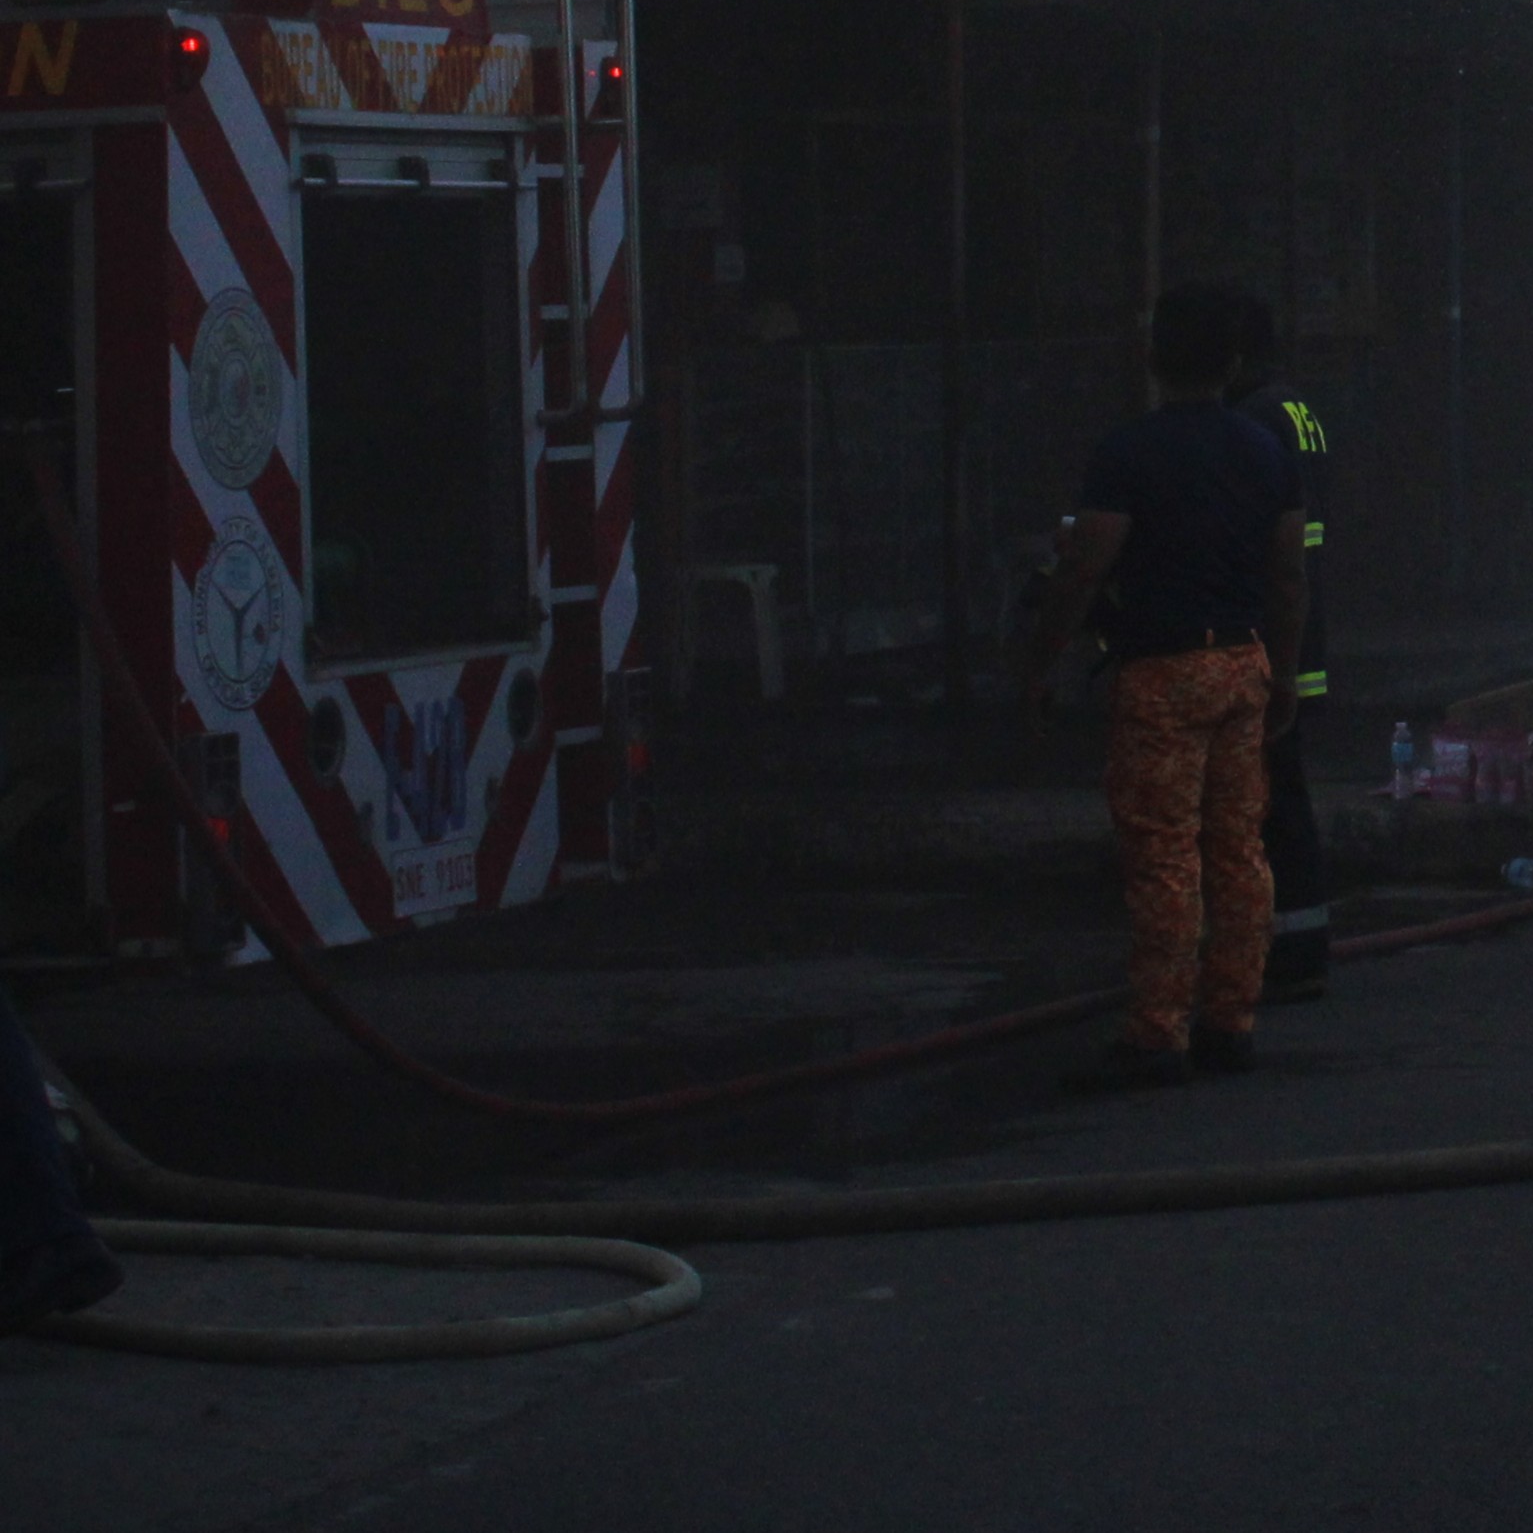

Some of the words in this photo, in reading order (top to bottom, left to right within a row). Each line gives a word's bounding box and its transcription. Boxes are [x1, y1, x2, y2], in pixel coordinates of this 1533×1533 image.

[261, 30, 341, 109] BUREAU
[346, 35, 371, 109] OF
[377, 38, 419, 111] FIRE
[425, 41, 534, 115] PROTECTION
